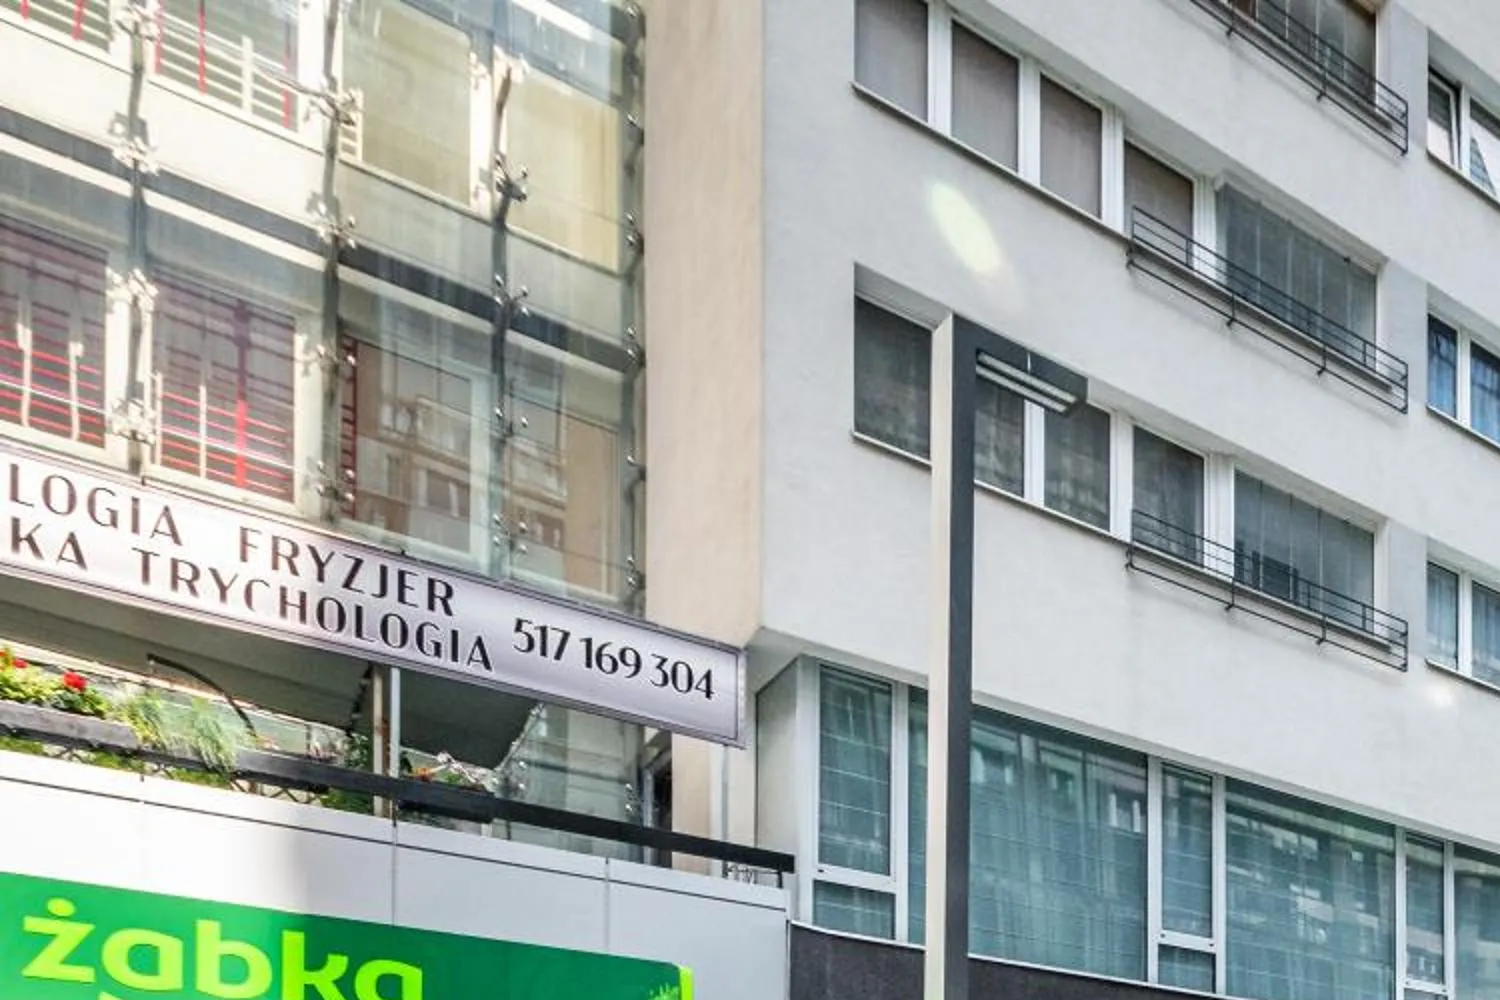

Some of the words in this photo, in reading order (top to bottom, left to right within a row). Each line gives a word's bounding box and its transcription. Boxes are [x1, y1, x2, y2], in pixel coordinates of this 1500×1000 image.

[9, 463, 183, 548] LOGIA
[239, 525, 456, 618] FRYZJER
[11, 516, 88, 571] KA
[132, 546, 493, 672] TRYCHOLOGIA
[512, 617, 571, 662] 517
[581, 635, 641, 680] 169
[650, 654, 715, 700] 304
